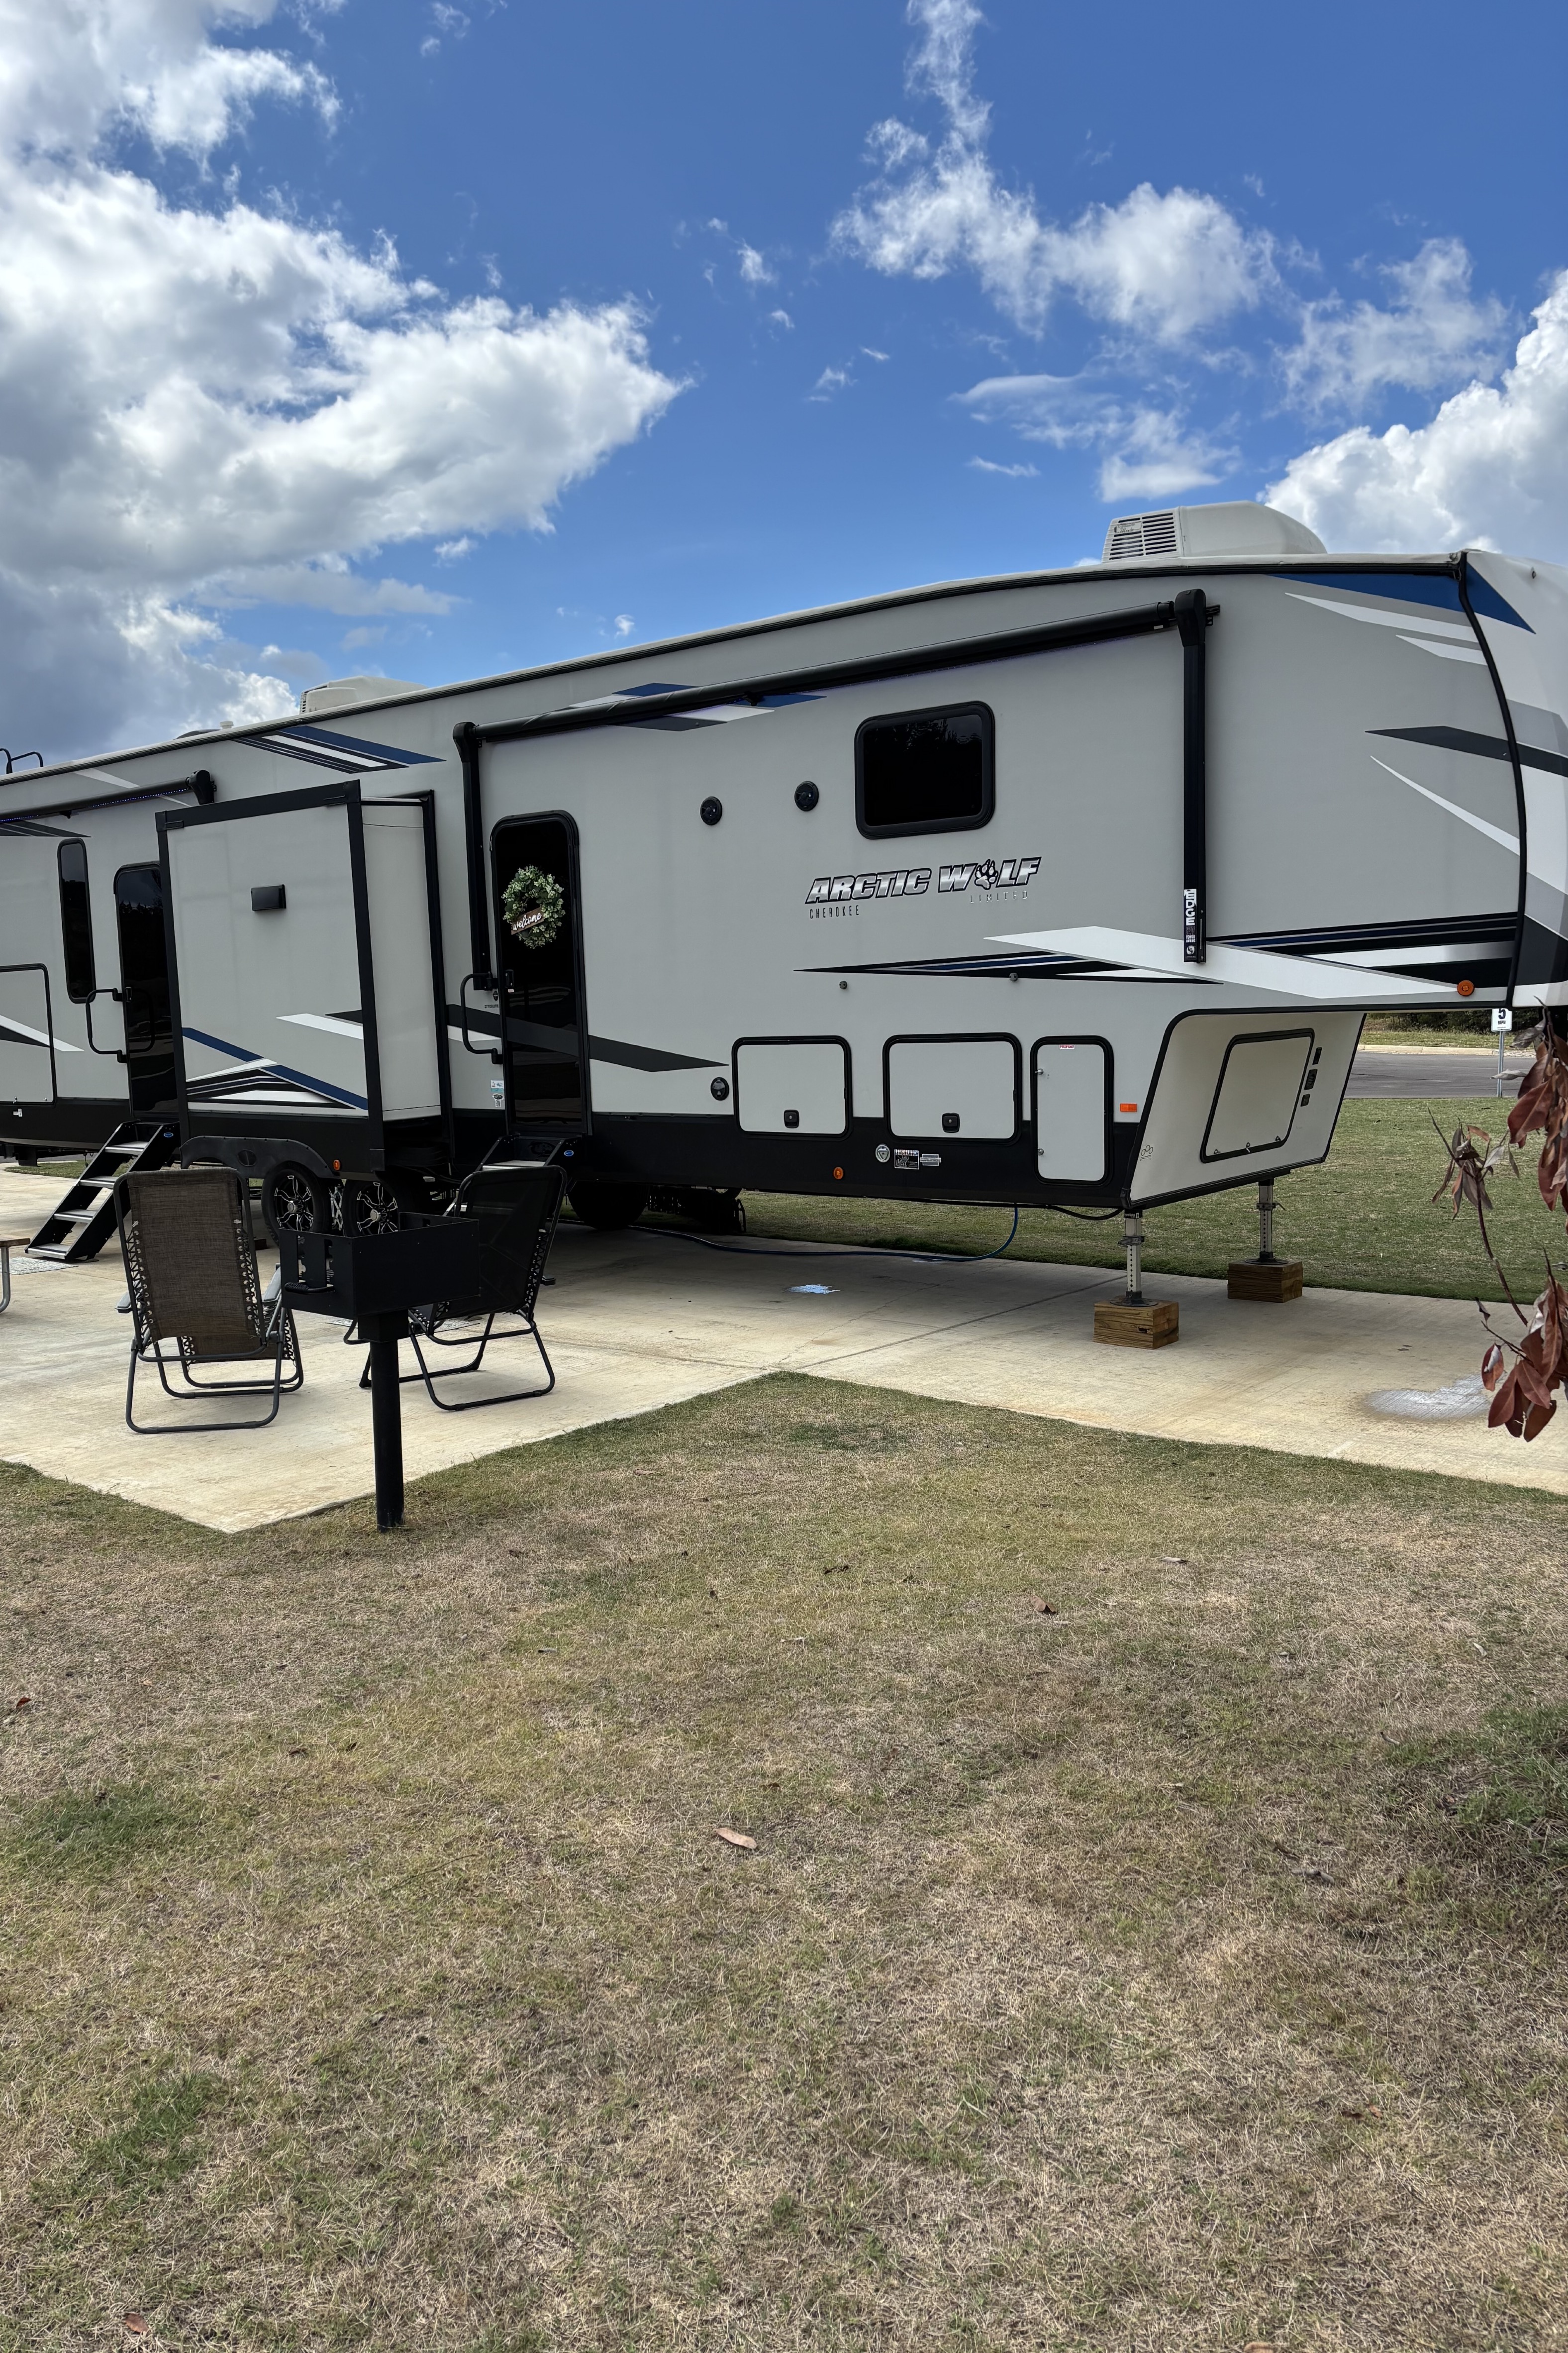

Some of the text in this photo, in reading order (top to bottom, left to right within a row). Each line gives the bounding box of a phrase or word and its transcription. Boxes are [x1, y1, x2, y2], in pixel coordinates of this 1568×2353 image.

[804, 868, 932, 905] ARCTIC
[970, 890, 1028, 904] LIMITED
[810, 905, 860, 919] CHEROKEE
[1185, 889, 1195, 926] EDGE
[513, 913, 542, 931] welcome
[1498, 1008, 1506, 1020] 5
